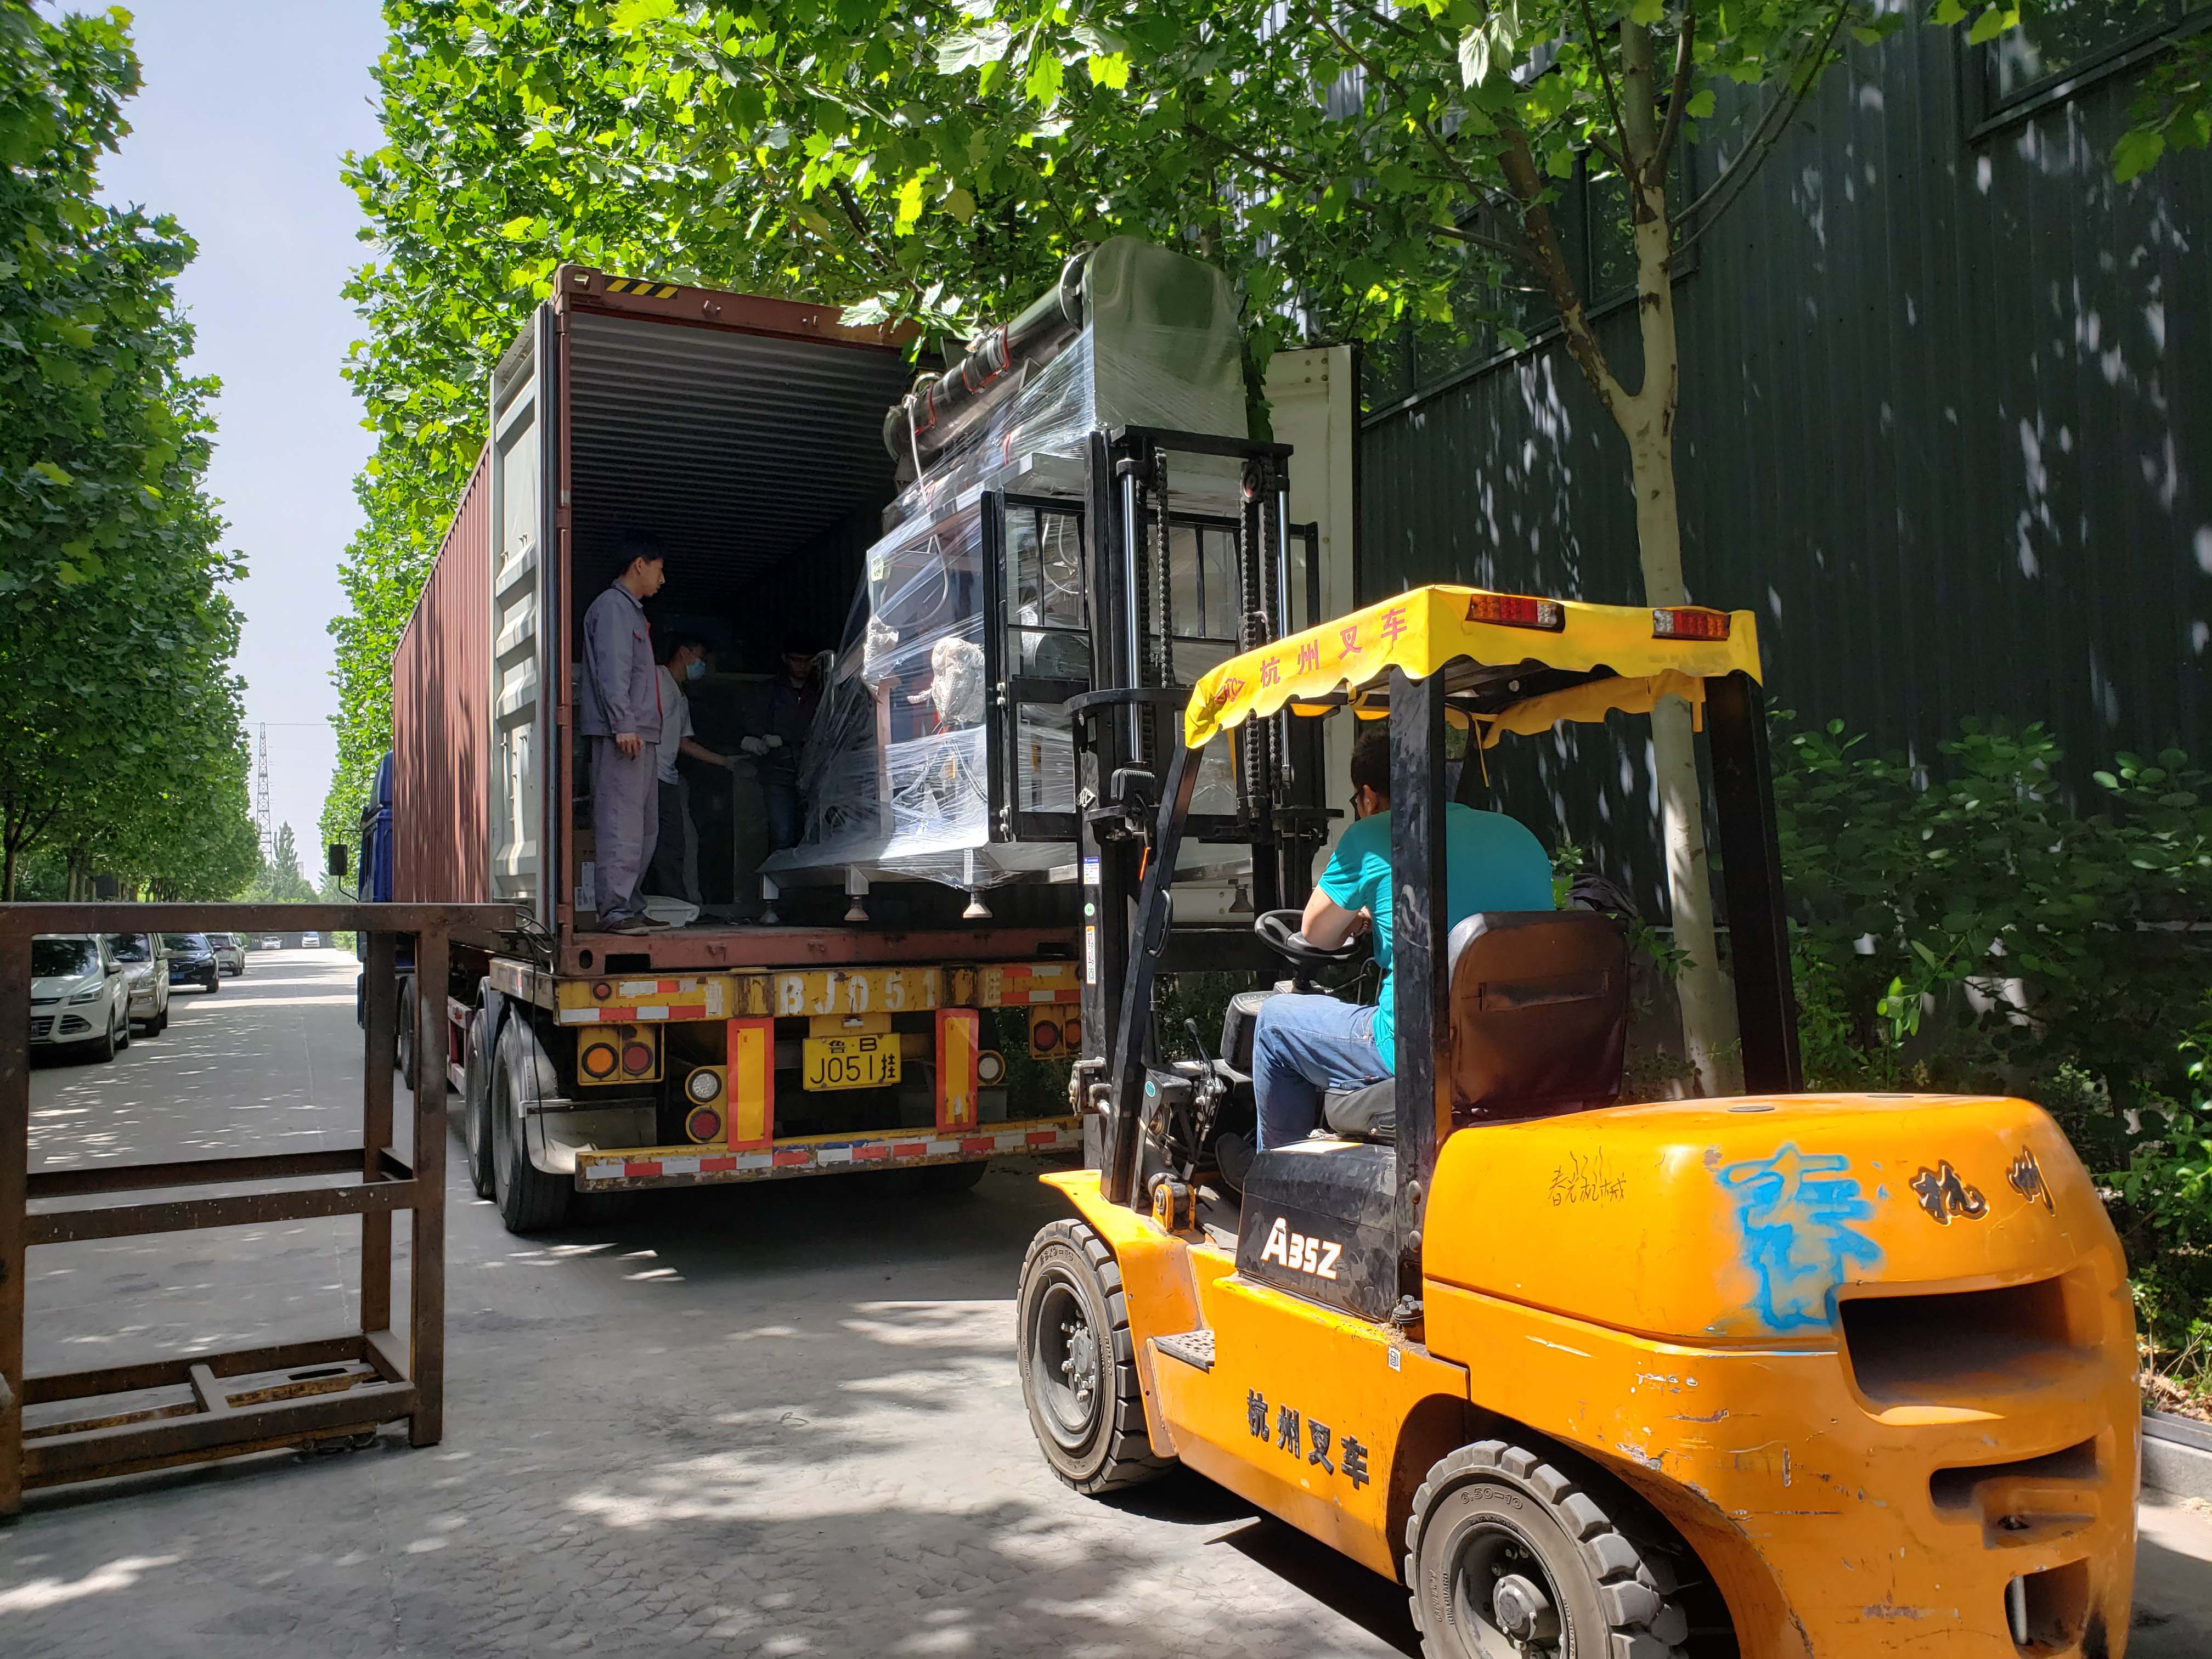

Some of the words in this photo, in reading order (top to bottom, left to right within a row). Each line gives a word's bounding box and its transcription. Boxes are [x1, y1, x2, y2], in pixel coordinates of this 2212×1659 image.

[1260, 607, 1407, 688] 杭州叉车
[810, 1053, 895, 1084] J051挂
[1246, 1387, 1369, 1490] 杭州叉车
[1460, 1486, 1523, 1510] 6.50-10
